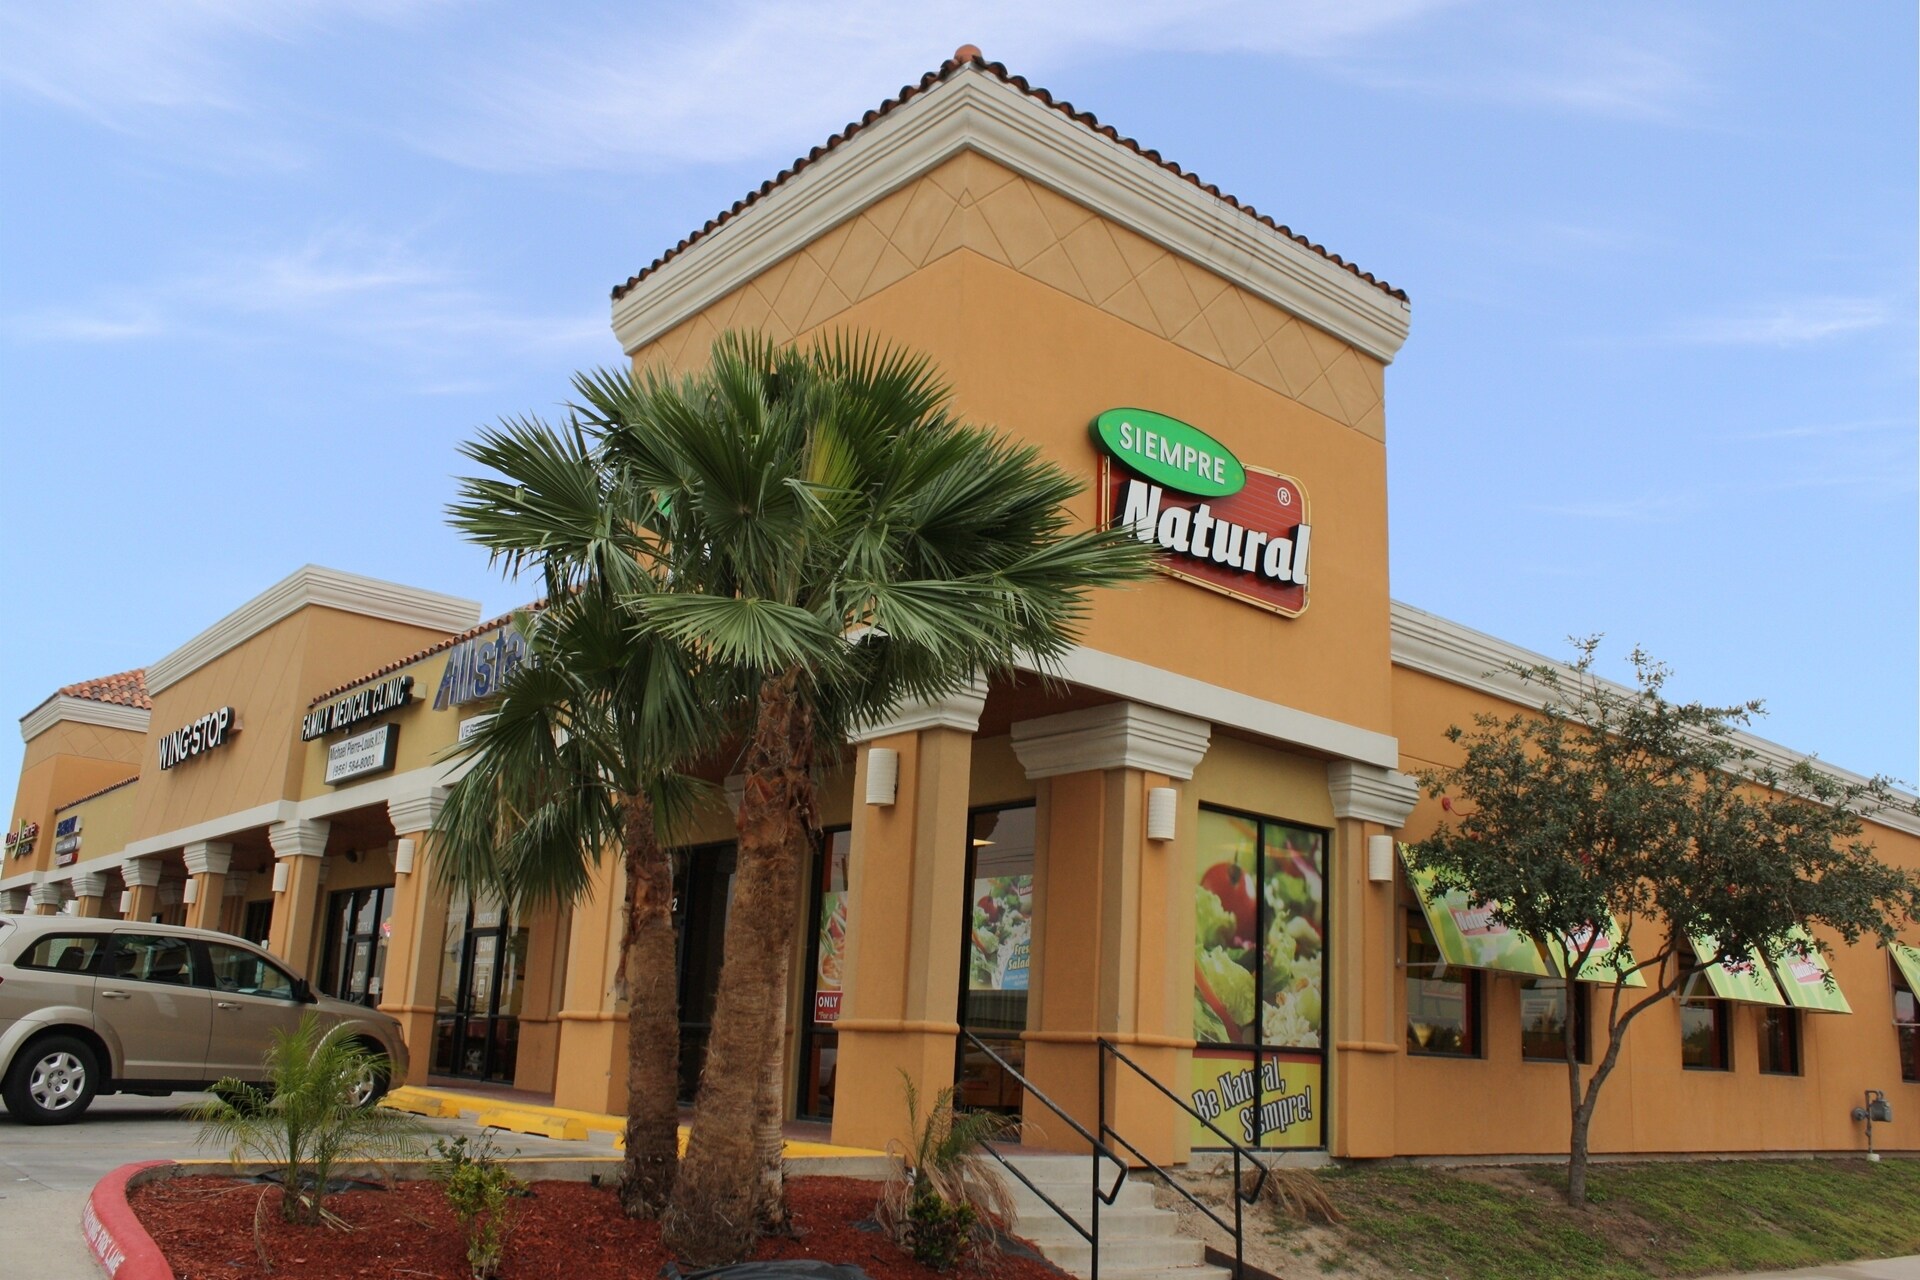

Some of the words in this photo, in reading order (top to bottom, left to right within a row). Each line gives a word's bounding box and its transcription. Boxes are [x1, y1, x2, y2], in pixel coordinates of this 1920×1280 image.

[1119, 421, 1226, 485] SIEMPRE
[1121, 478, 1312, 586] Natural
[432, 625, 542, 712] Allsta
[301, 705, 331, 741] FAMILY
[331, 689, 371, 730] MEDICAL
[372, 674, 406, 714] CLINIC
[818, 996, 838, 1008] ONLY
[1192, 1089, 1220, 1127] Be
